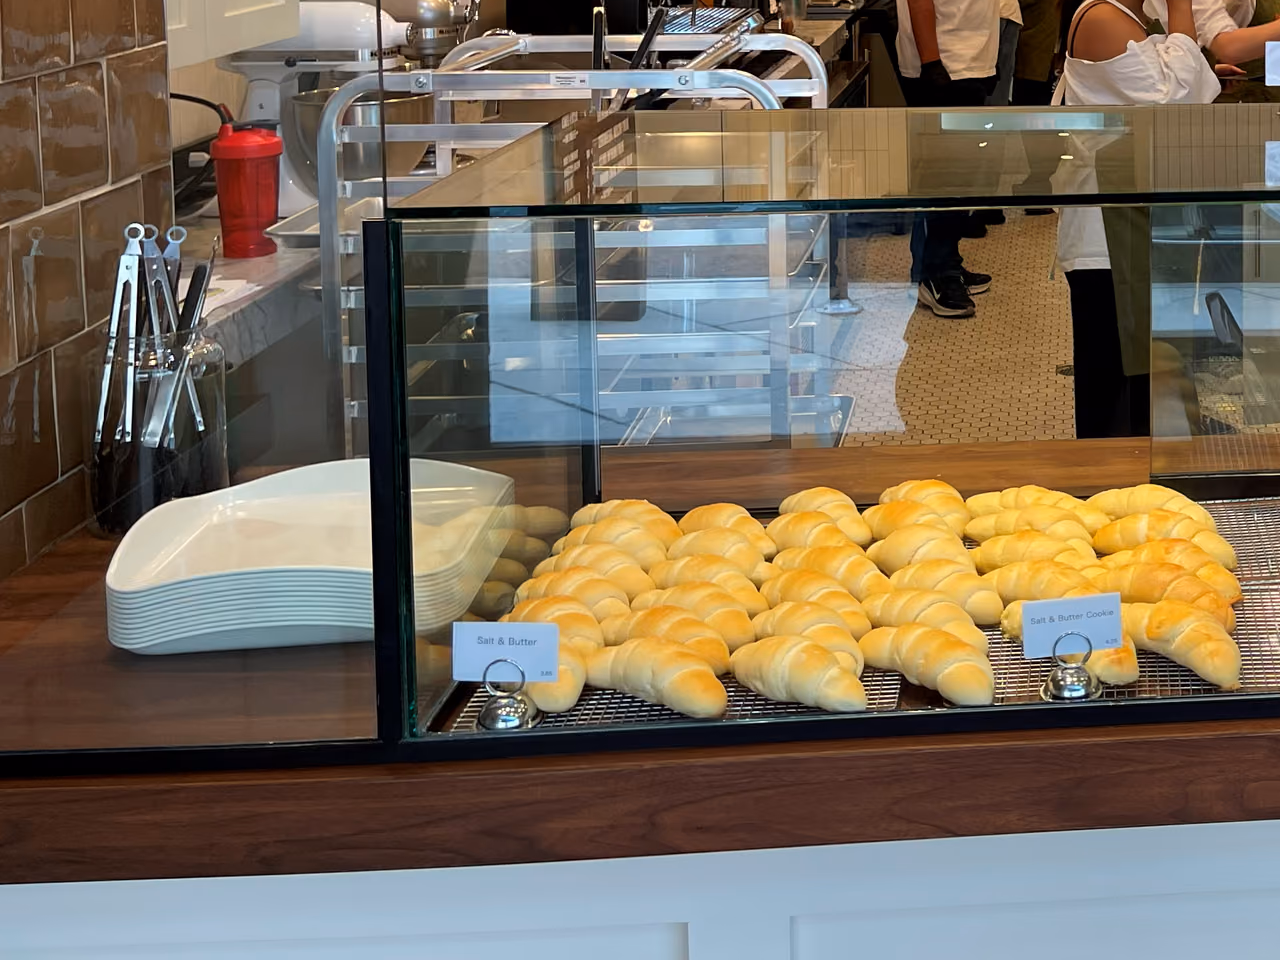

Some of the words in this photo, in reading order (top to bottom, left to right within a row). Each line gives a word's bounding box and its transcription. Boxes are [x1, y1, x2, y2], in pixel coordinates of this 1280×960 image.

[1030, 617, 1046, 625] Salt
[1048, 615, 1055, 623] &
[1057, 613, 1084, 622] Butter
[1086, 609, 1114, 619] Cookie
[477, 635, 495, 645] Salt
[497, 636, 505, 645] &
[508, 637, 538, 646] Butter
